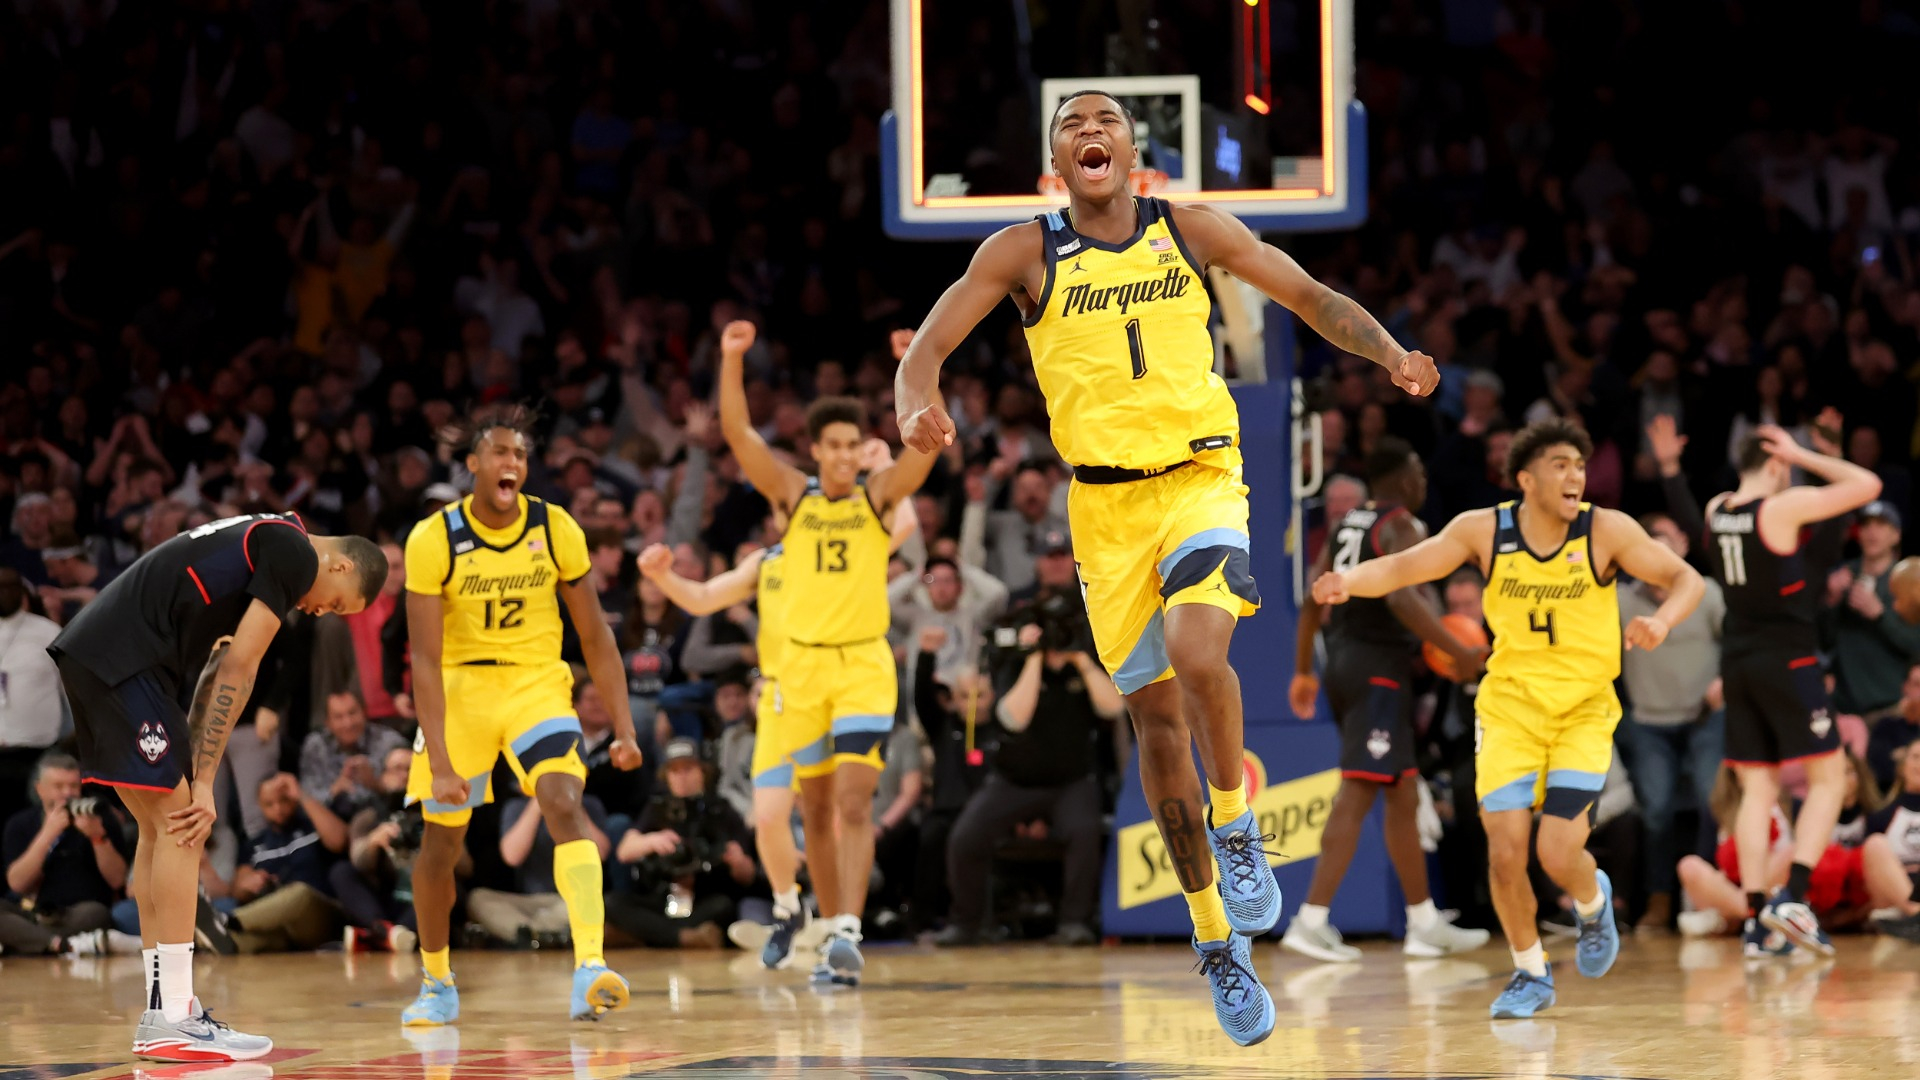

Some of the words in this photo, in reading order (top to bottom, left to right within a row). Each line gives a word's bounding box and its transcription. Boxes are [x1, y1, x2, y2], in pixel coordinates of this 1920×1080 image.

[1062, 267, 1190, 317] Marquette
[1125, 318, 1148, 380] 1
[802, 511, 869, 536] Marquette
[816, 540, 849, 573] 13
[1718, 534, 1747, 586] 11
[459, 565, 552, 597] Marquette
[1499, 577, 1591, 605] Marquette
[484, 598, 526, 630] 12
[1528, 607, 1559, 646] 4
[201, 684, 237, 758] LOYALTY
